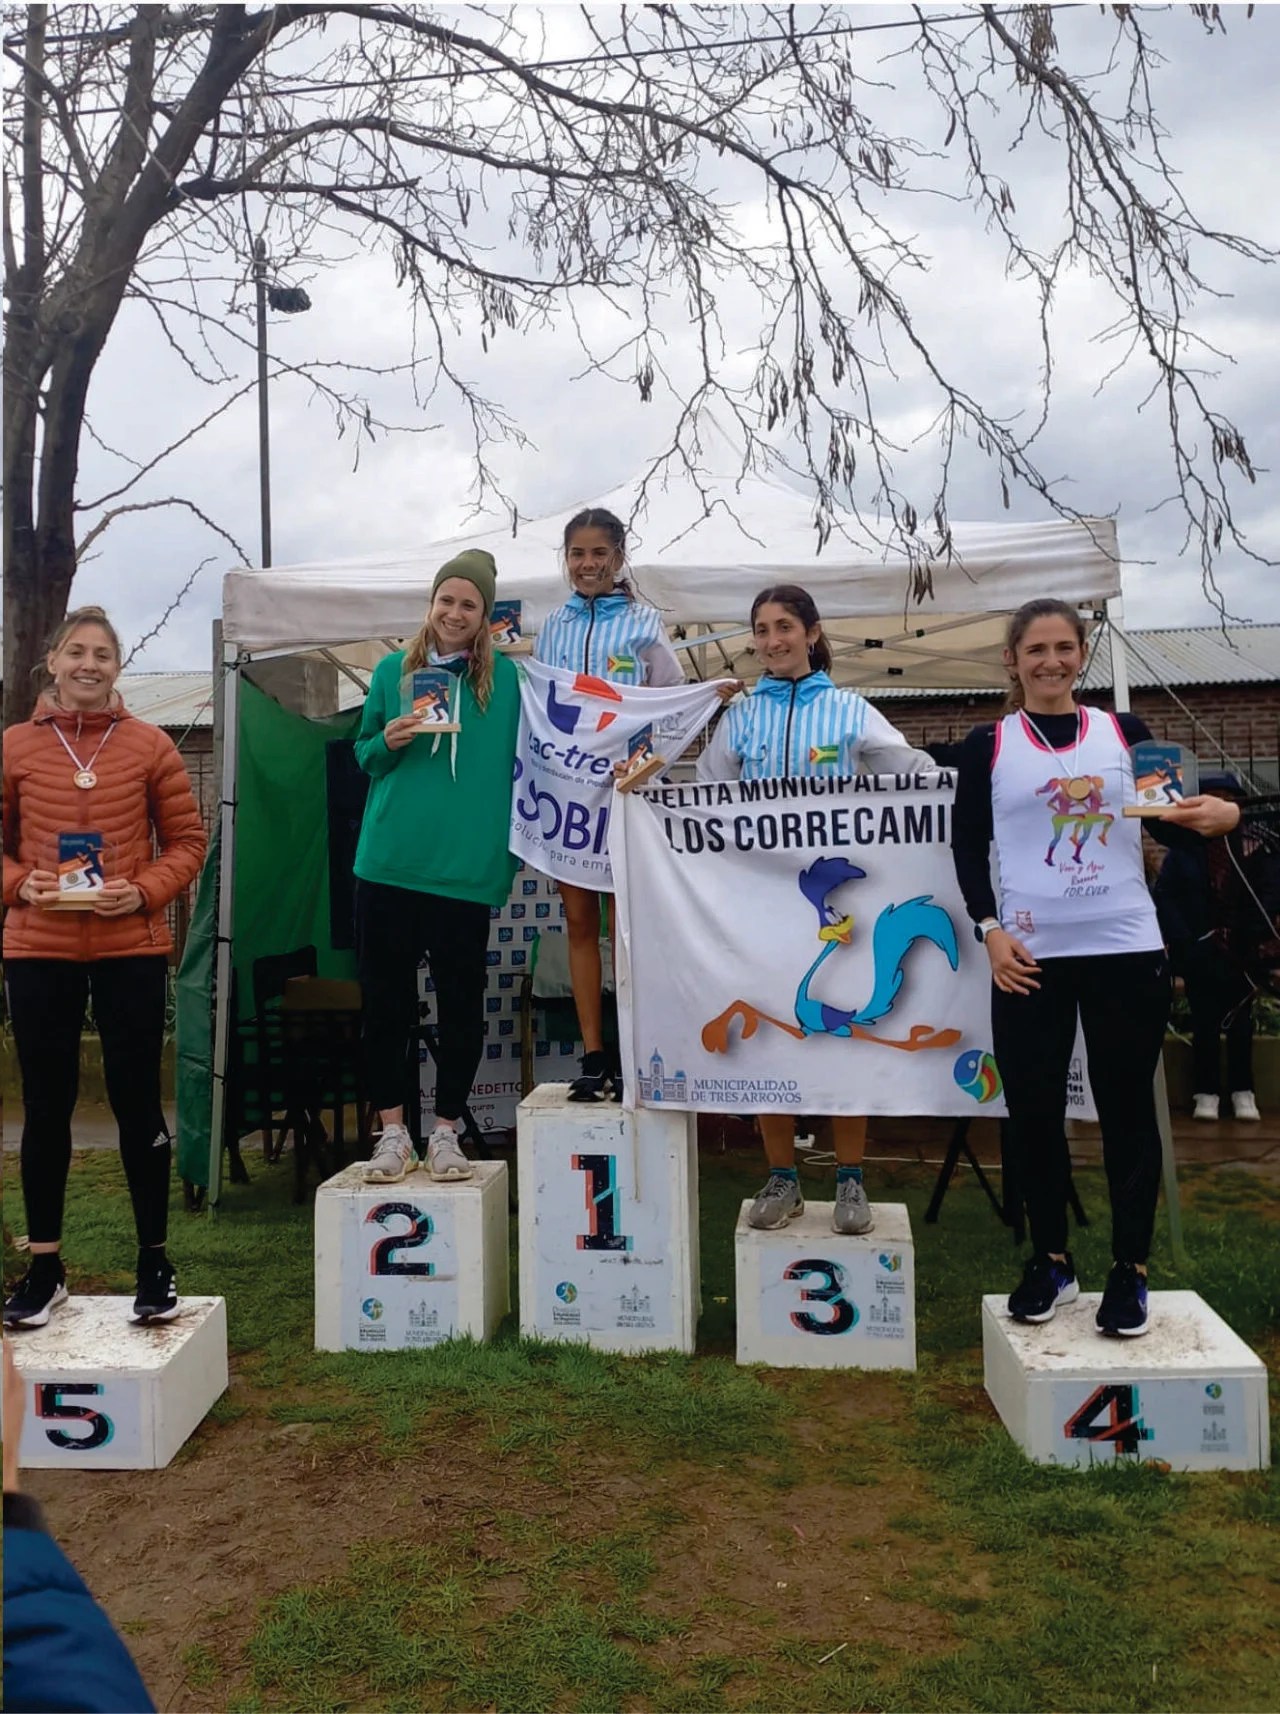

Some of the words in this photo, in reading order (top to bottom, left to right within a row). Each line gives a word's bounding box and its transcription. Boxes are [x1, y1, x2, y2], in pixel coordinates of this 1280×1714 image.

[739, 774, 887, 804] MUNICIPAL
[895, 773, 928, 791] DE
[550, 850, 576, 866] para
[665, 816, 725, 854] LOS
[733, 804, 957, 852] CORRECAMI
[691, 1091, 707, 1102] DE
[709, 1091, 738, 1102] TRES
[740, 1091, 802, 1103] ARROYOS
[694, 1079, 798, 1091] MUNICIPALIDAD
[570, 1153, 633, 1251] 1
[365, 1201, 436, 1276] 2
[782, 1257, 860, 1336] 3
[35, 1382, 115, 1451] 5
[1063, 1384, 1155, 1454] 4
